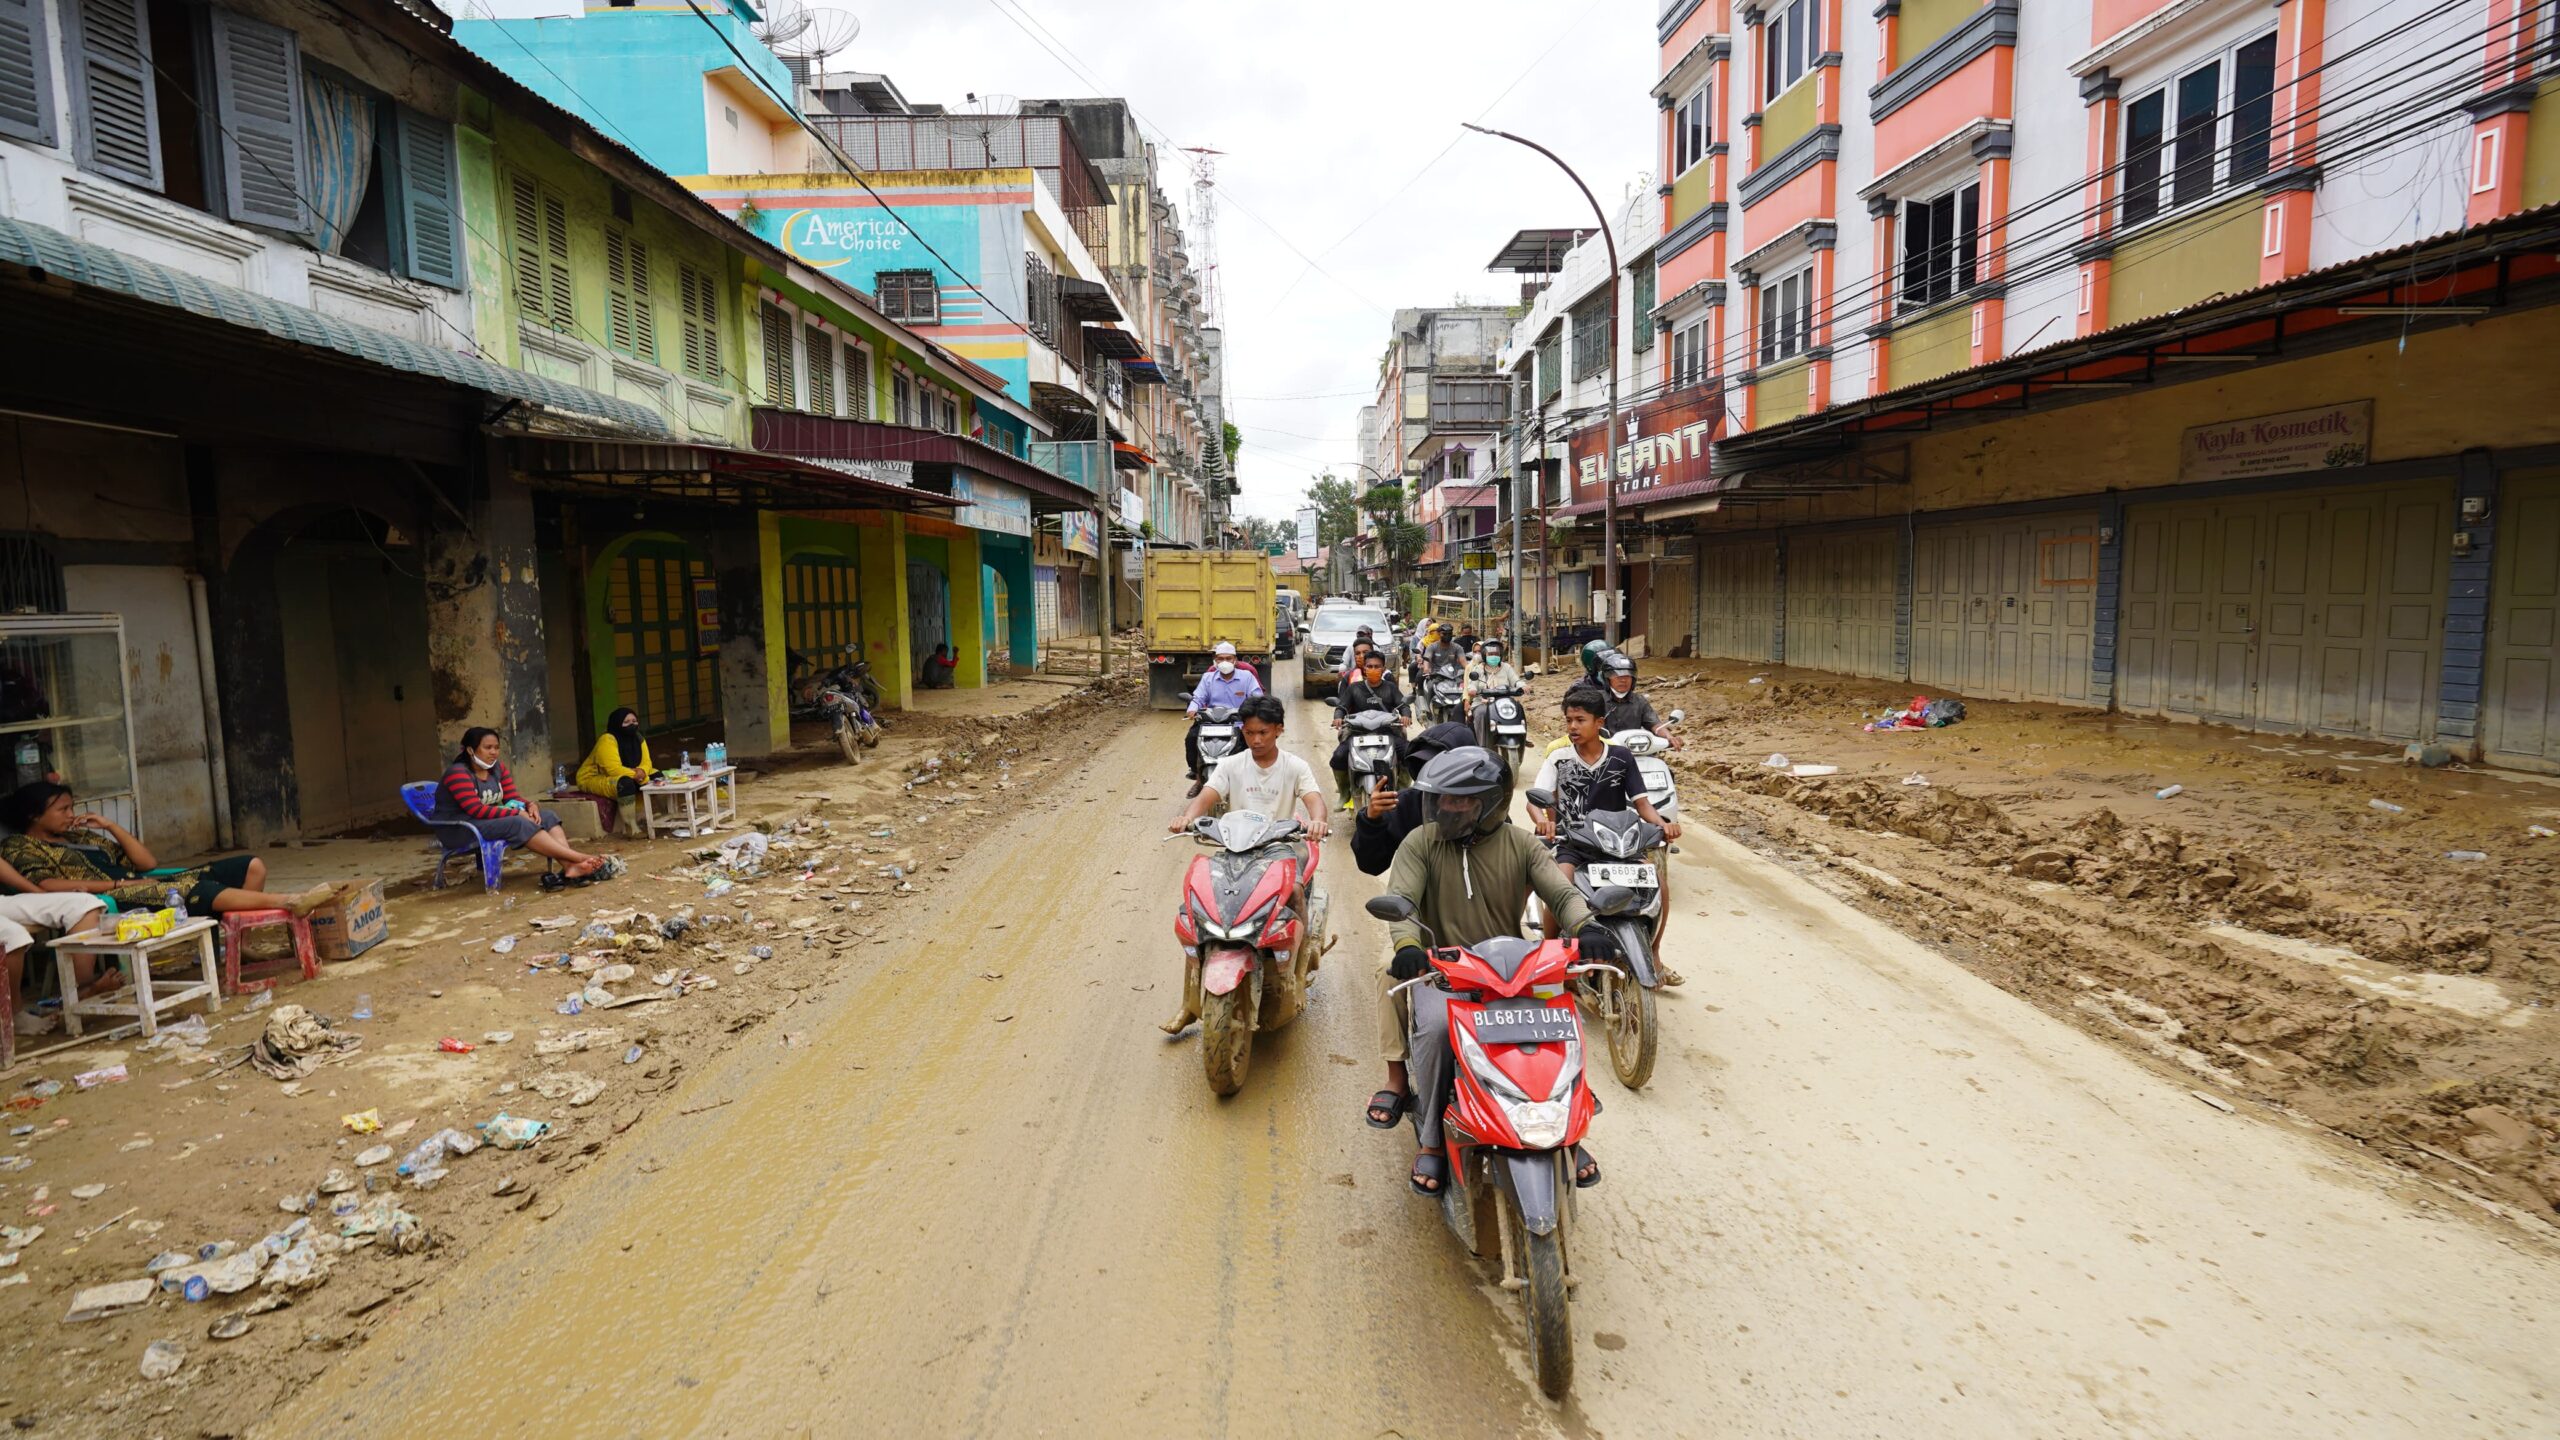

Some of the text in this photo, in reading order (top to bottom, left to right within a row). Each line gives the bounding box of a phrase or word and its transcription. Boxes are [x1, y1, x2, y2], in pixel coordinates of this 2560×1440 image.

[801, 214, 908, 245] America's
[840, 230, 902, 252] Choice
[2194, 411, 2353, 453] Kayla Kosmetik
[353, 905, 382, 931] AMOZ
[1473, 1008, 1572, 1026] BL 6873 UAG
[1533, 1029, 1575, 1039] 11-24
